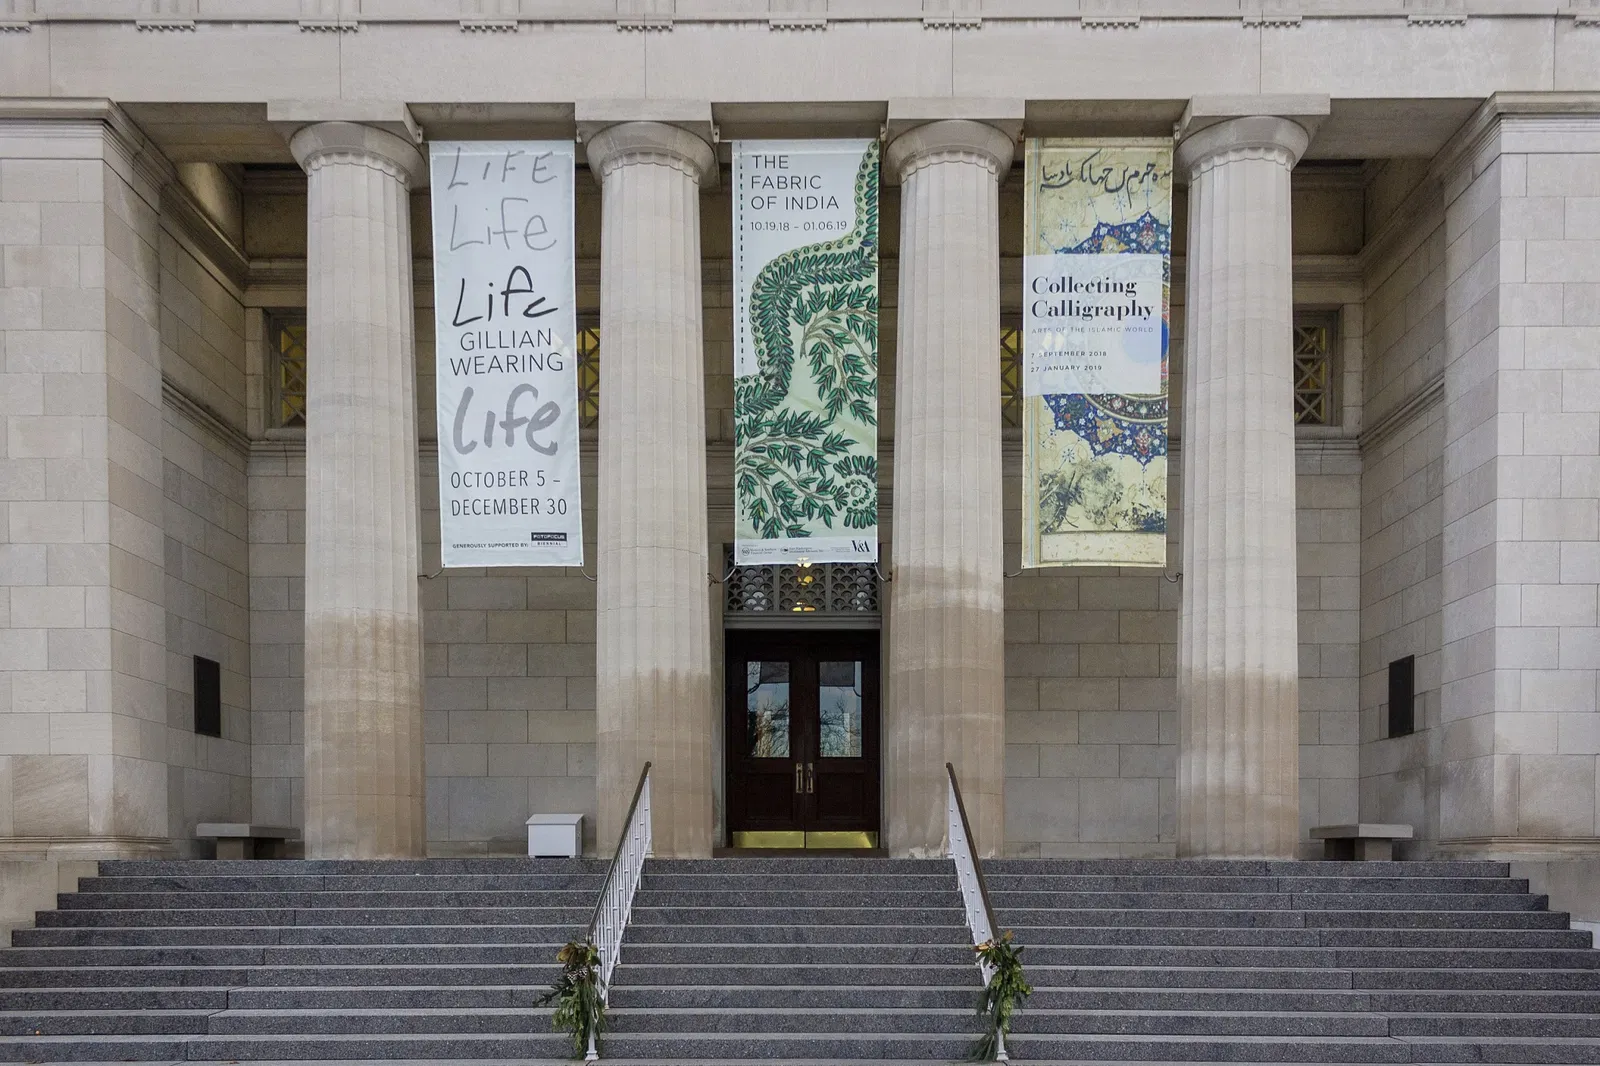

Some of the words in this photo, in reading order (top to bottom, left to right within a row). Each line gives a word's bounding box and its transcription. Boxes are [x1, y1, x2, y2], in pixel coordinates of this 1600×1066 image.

[752, 155, 789, 169] THE
[751, 175, 822, 189] FABRIC
[751, 196, 777, 210] OF
[785, 195, 839, 210] INDIA
[751, 221, 790, 231] 10.19.18
[803, 220, 847, 231] 01.06.19
[1032, 275, 1137, 297] Collecting
[453, 265, 559, 326] Life
[1031, 300, 1154, 321] Calligraphy
[460, 328, 551, 351] GILLIAN
[1038, 350, 1085, 358] SEPTEMBER
[450, 352, 563, 376] WEARING
[450, 470, 529, 489] OCTOBER
[536, 470, 546, 487] 5
[451, 498, 540, 516] DECEMBER
[546, 498, 567, 515] 30
[851, 539, 870, 552] V&A
